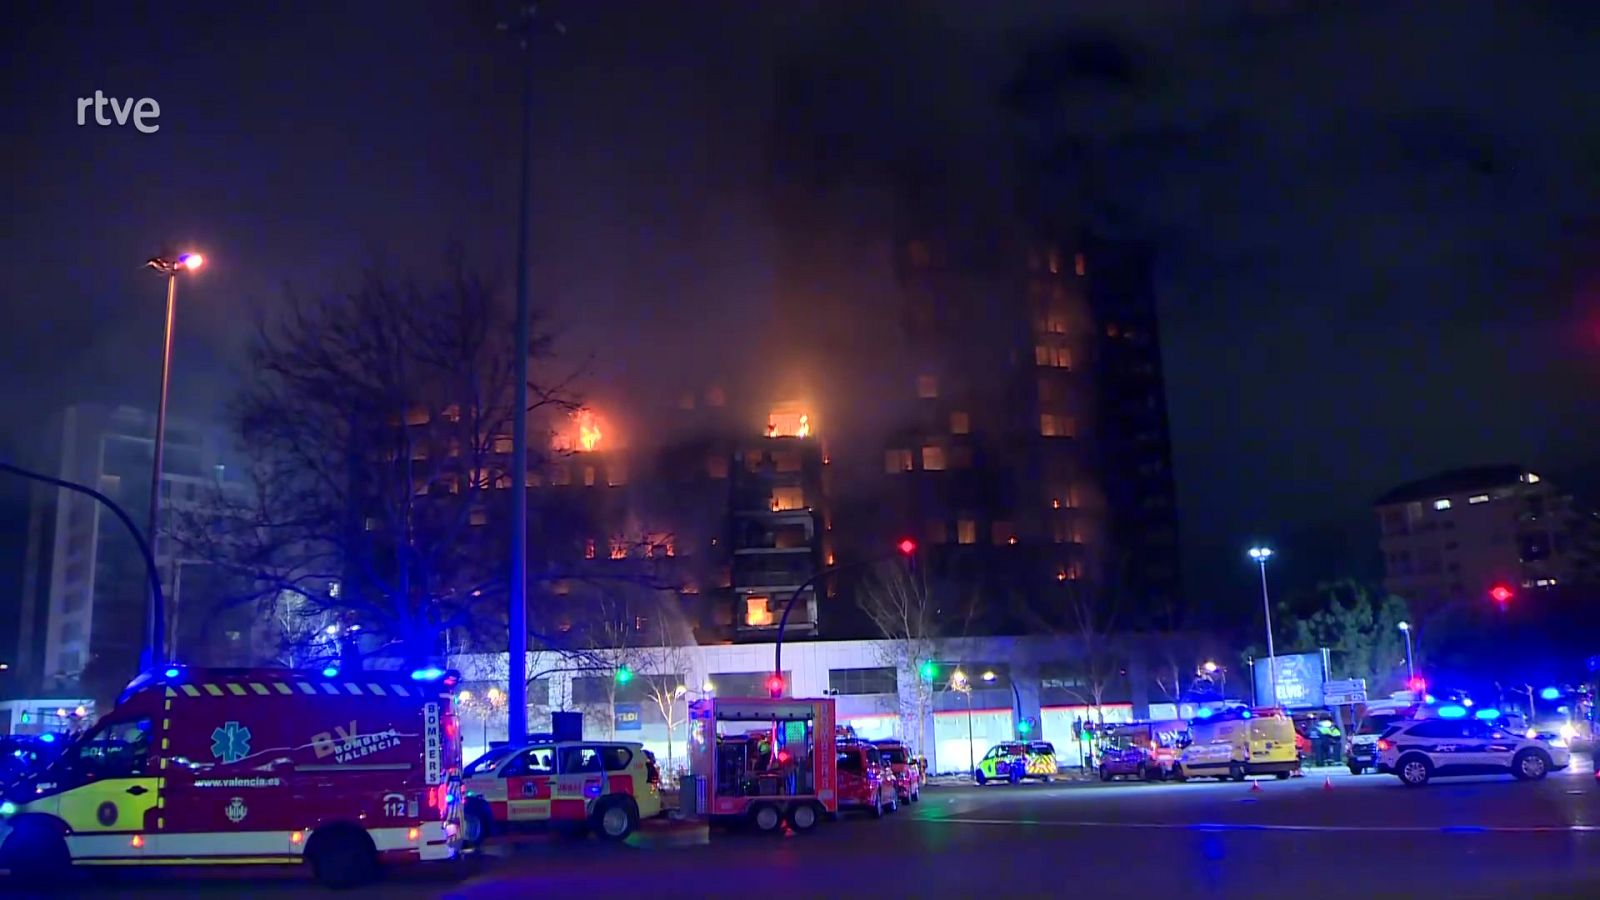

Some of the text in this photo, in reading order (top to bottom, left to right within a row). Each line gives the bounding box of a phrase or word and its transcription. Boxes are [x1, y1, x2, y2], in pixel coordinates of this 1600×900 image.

[426, 703, 438, 783] BOMBERS
[194, 777, 280, 788] www.valencia.es
[384, 803, 405, 817] 112
